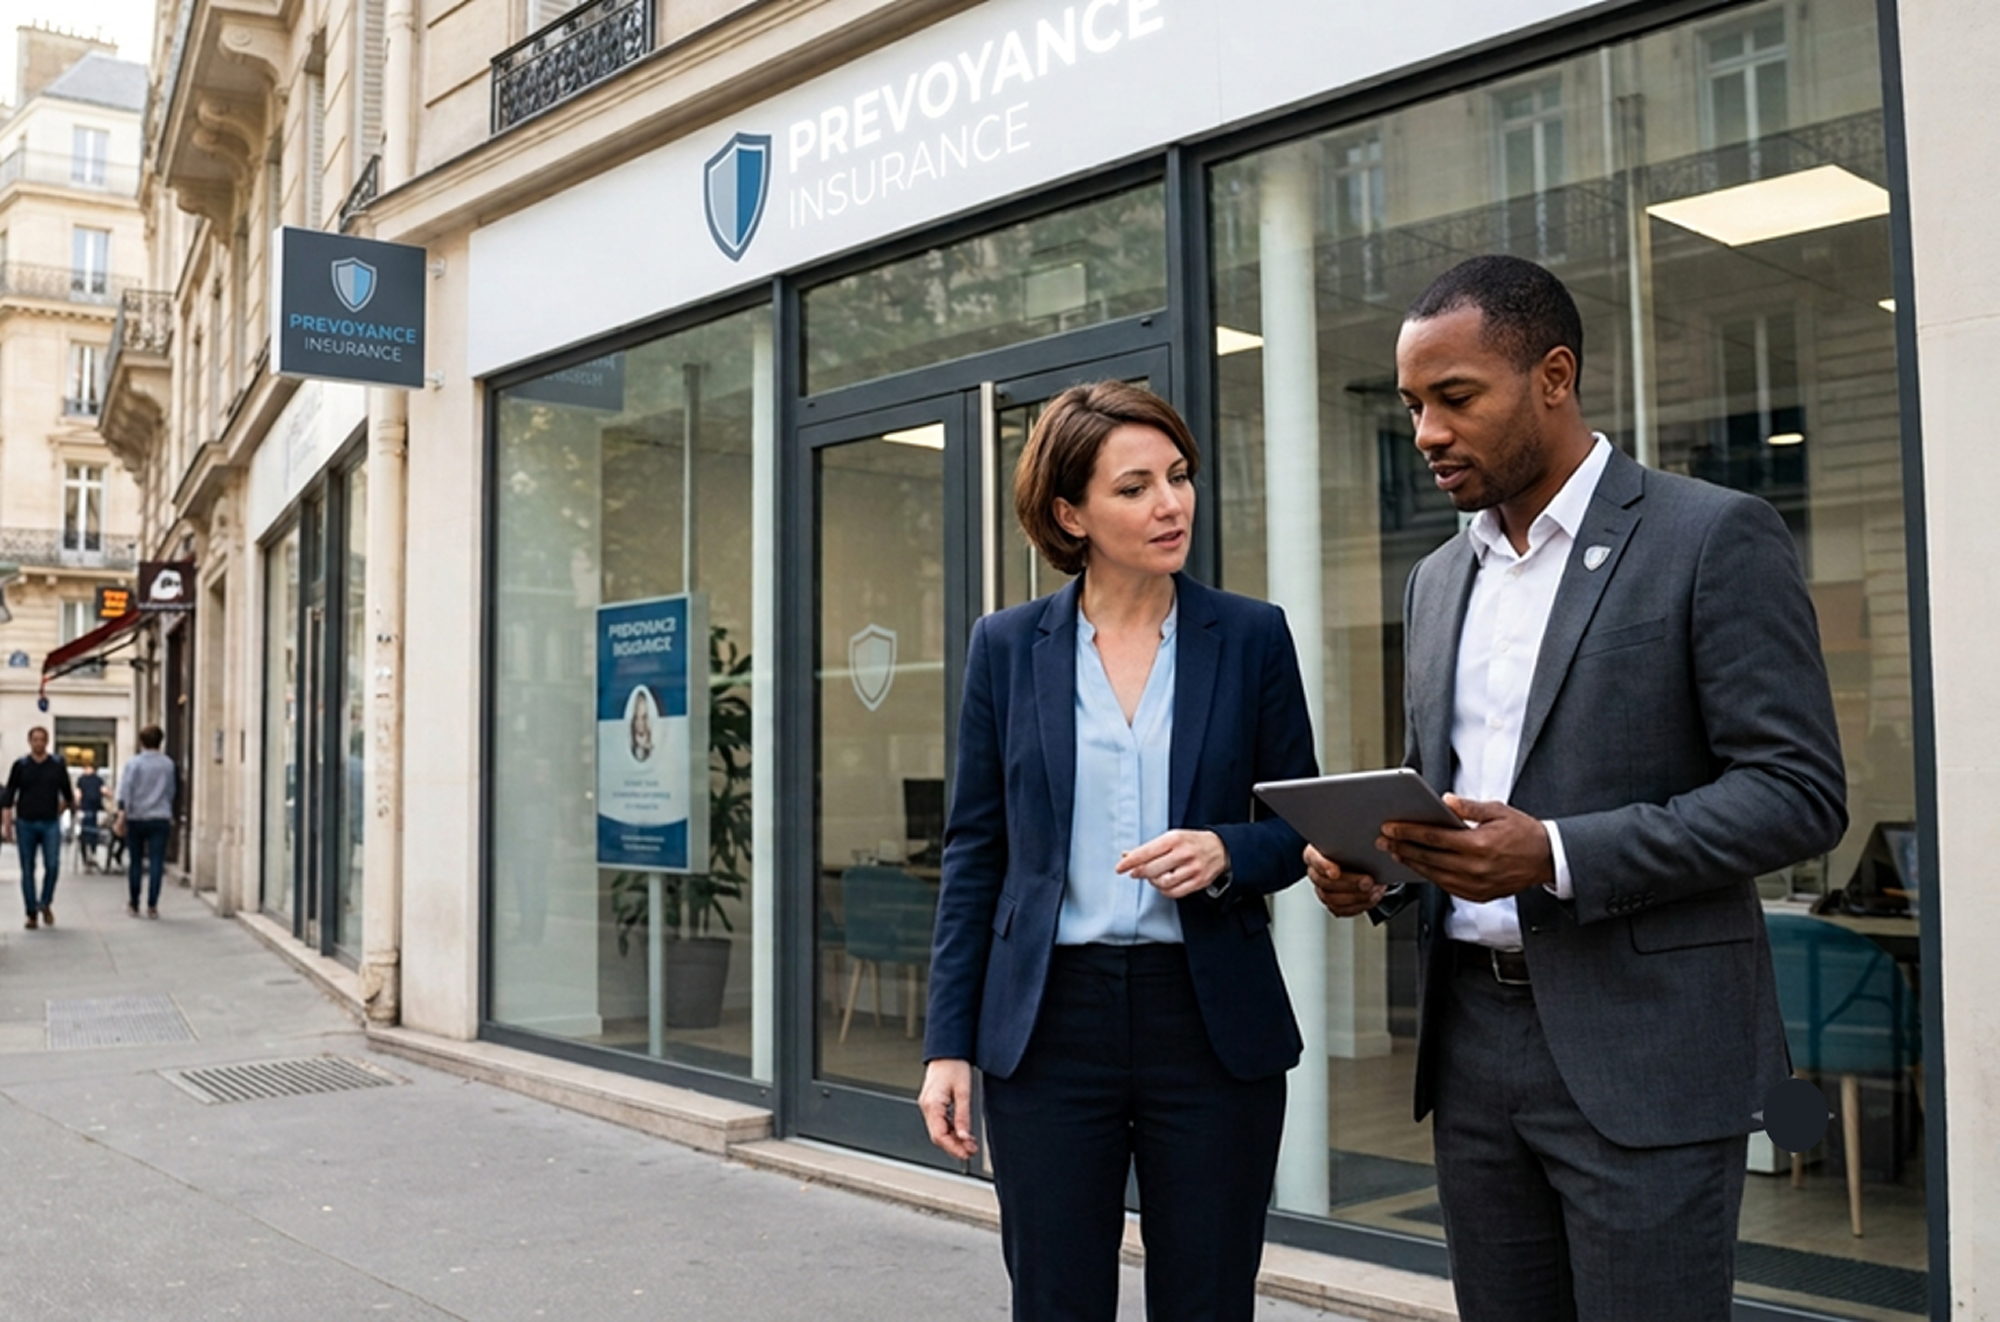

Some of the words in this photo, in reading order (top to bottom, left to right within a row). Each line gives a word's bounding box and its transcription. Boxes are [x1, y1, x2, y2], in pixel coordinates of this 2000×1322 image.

[788, 0, 1164, 173] PREVOYANCE
[789, 101, 1032, 230] INSURANCE
[289, 313, 417, 345] PREVOYANCE
[304, 336, 402, 362] INSURANCE
